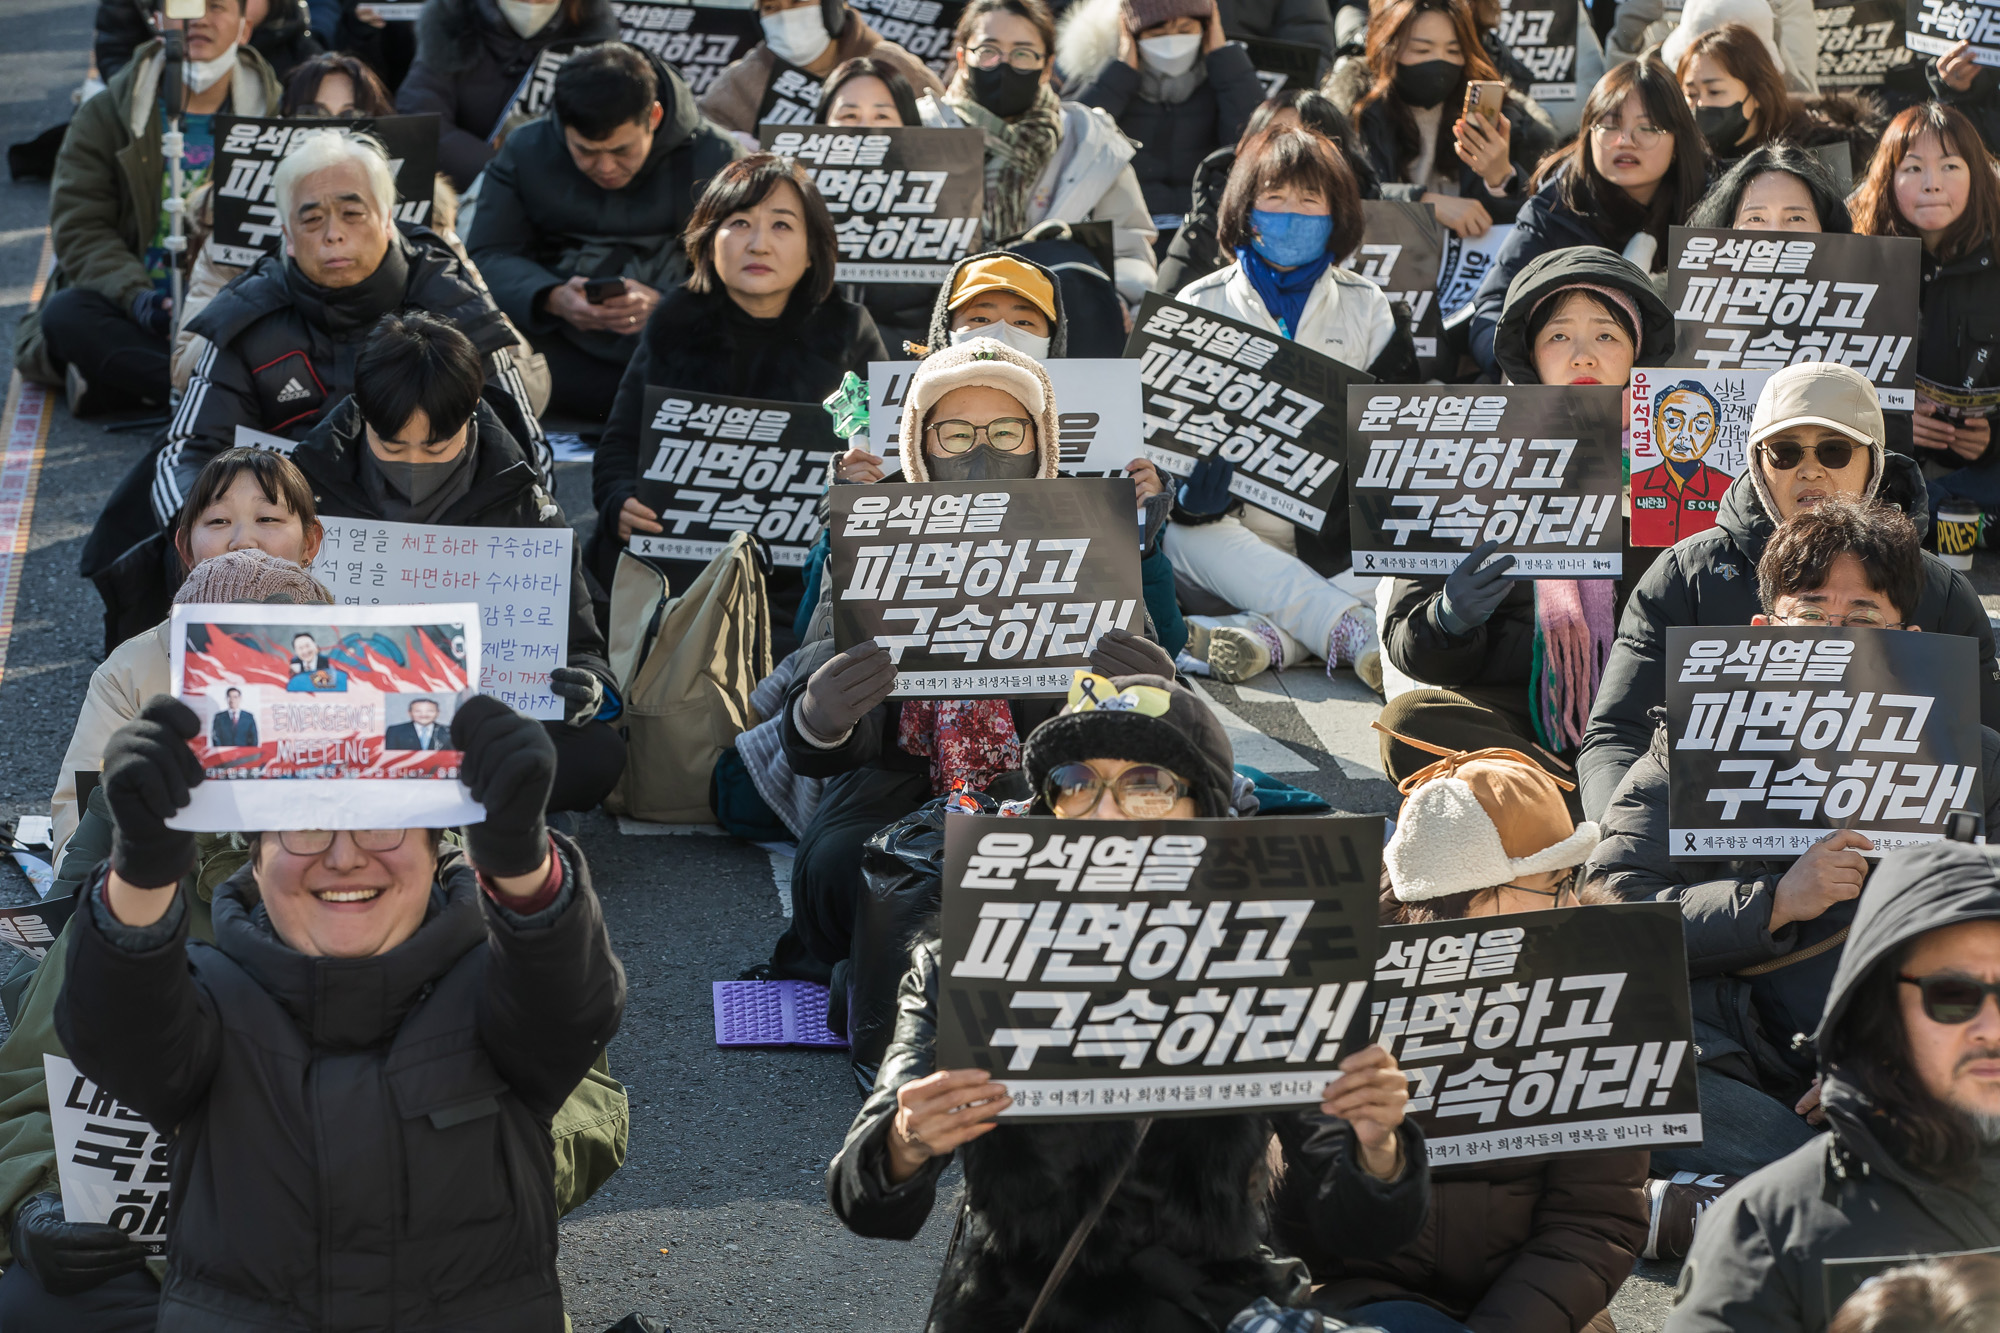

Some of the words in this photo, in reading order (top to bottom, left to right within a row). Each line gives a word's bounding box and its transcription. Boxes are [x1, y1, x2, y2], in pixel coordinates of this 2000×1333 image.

[770, 132, 892, 166] 윤석열을
[804, 168, 949, 213] 면하고
[834, 216, 980, 260] 속하라!
[1677, 236, 1816, 274] 윤석열을
[1674, 276, 1879, 328] 파면하고
[1142, 305, 1279, 370] 윤석열을
[1141, 341, 1325, 439] 파면하고
[651, 397, 791, 443] 윤석열을
[1358, 395, 1508, 432] 윤석열을
[1632, 372, 1656, 457] 윤석열
[642, 437, 834, 495] 파면하고
[1143, 393, 1340, 498] 구속하라!
[1355, 438, 1578, 490] 파면하고
[842, 492, 1011, 537] 윤석열을
[1381, 494, 1617, 547] 구속하라!
[1687, 500, 1718, 511] 504
[401, 533, 479, 557] 체포하라
[487, 536, 563, 559] 구속하라
[309, 559, 388, 587] 석열을
[401, 567, 480, 590] 파면하라
[485, 572, 562, 597] 수사하라
[840, 538, 1091, 601] 파면하고
[483, 604, 554, 628] 감옥으로
[481, 638, 516, 662] 제발
[1678, 639, 1855, 683] 윤석열을
[915, 677, 948, 690] 여객기
[952, 675, 974, 689] 참사
[977, 675, 1032, 688] 희생자들의
[1036, 673, 1069, 687] 명복을
[272, 704, 376, 732] EMERGENCY
[1675, 690, 1936, 754] 파면하고
[276, 737, 370, 765] MEETING
[960, 832, 1207, 892] 윤석열을
[1703, 836, 1748, 850] 제주항공
[1752, 836, 1785, 850] 여객기
[1789, 835, 1811, 849] 참사
[951, 899, 1315, 982] 파면하고
[1374, 927, 1525, 988] 석열을
[989, 979, 1368, 1071] 구속하라!
[1049, 1088, 1095, 1106] 여객기
[1466, 1139, 1493, 1156] 참사
[1497, 1130, 1563, 1152] 희생자들의
[1568, 1127, 1608, 1144] 명복을
[1614, 1123, 1653, 1140] 빕니다
